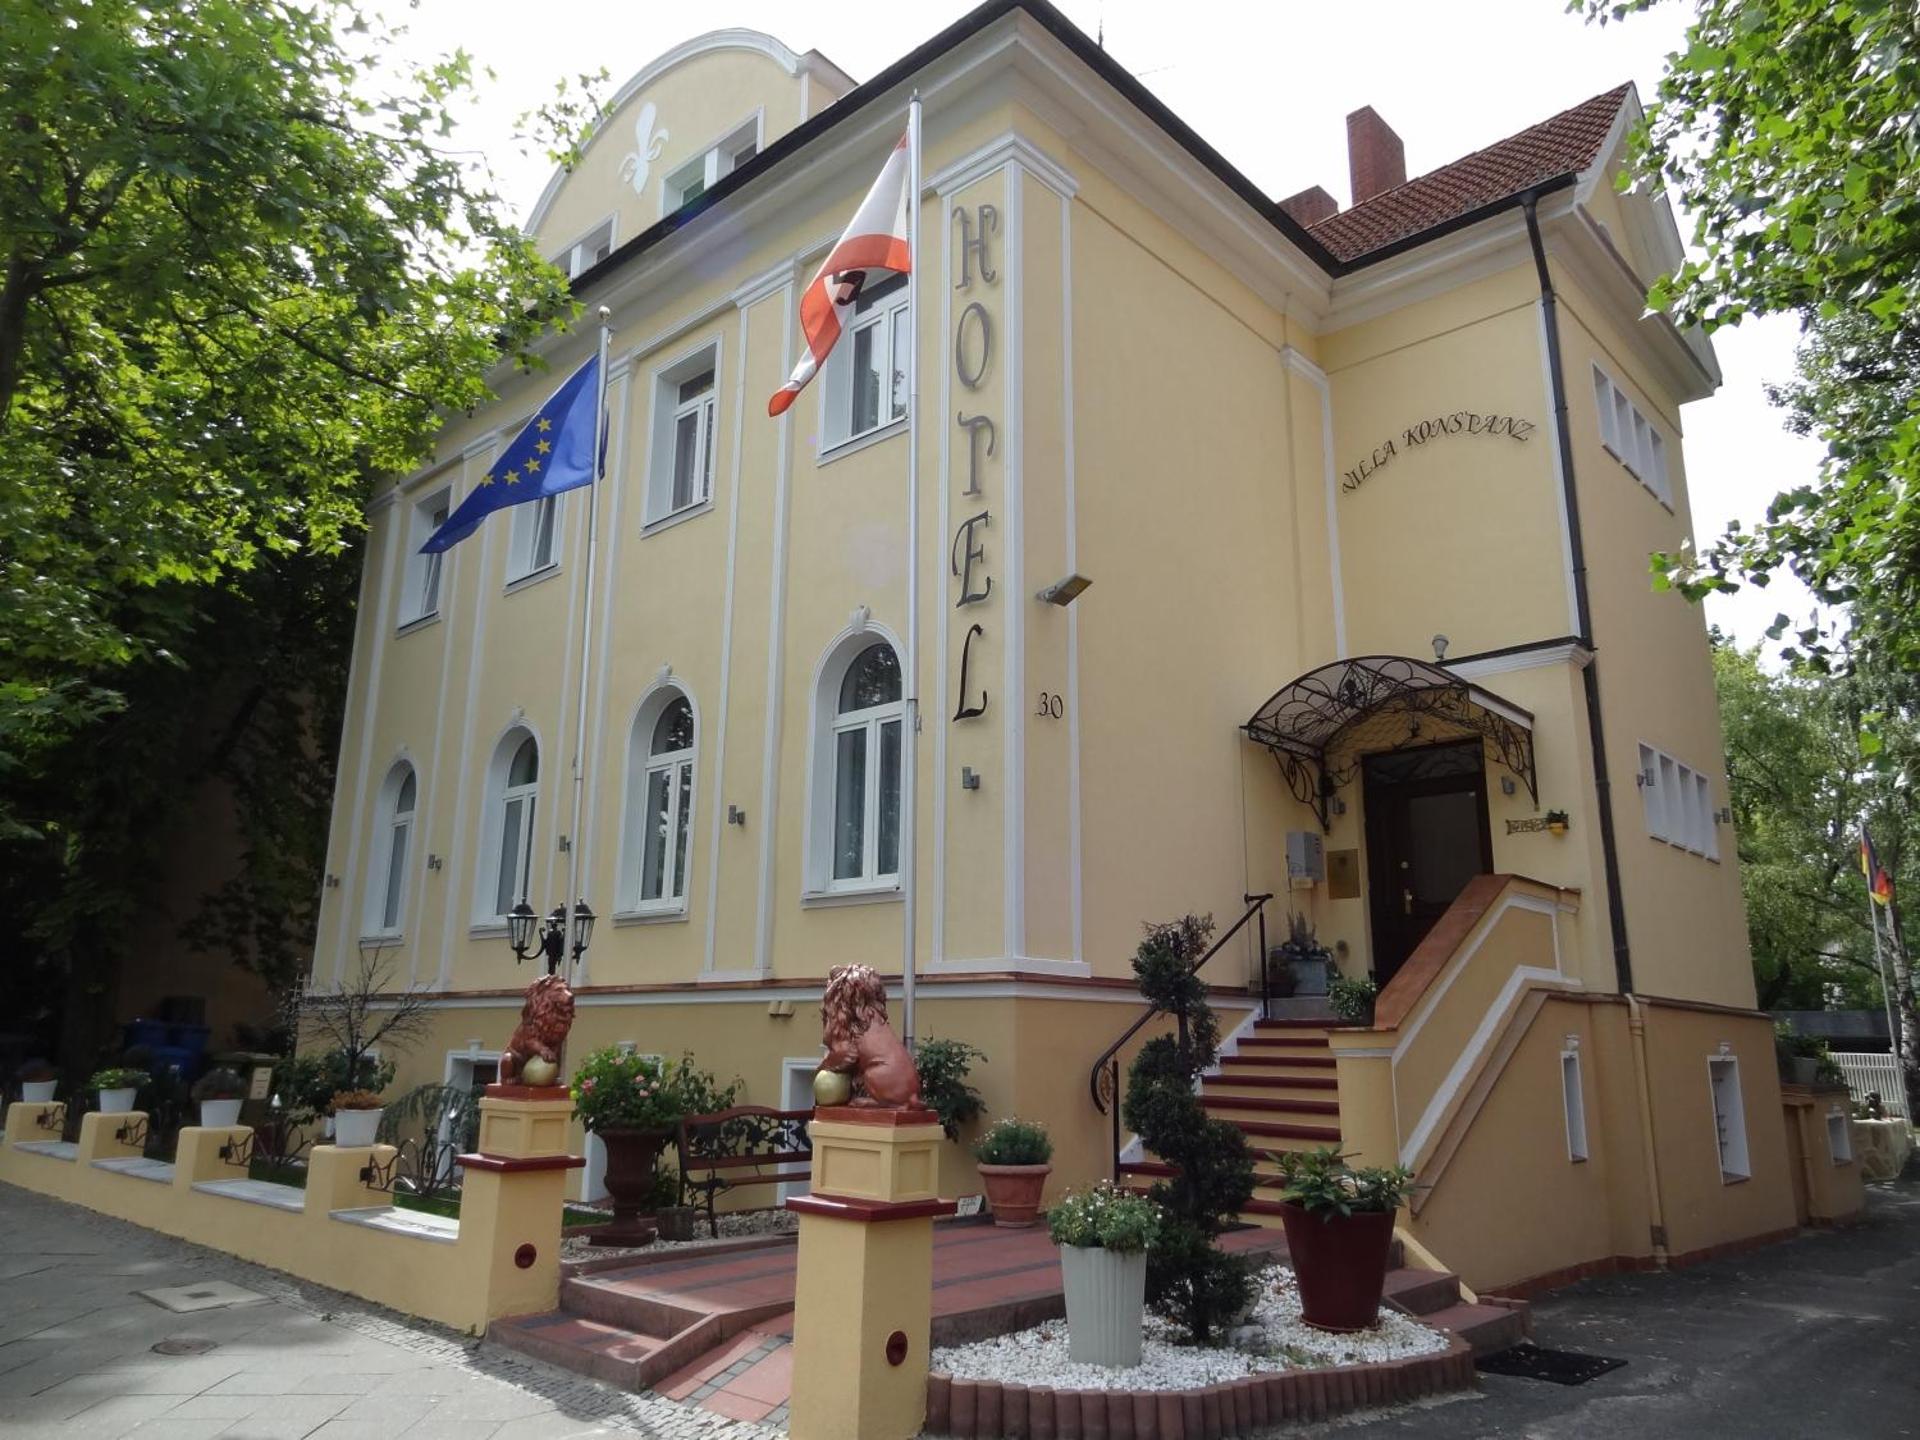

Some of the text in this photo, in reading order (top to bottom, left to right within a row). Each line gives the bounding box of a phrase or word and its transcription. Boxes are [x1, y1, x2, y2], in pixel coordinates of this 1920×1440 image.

[952, 204, 998, 722] HOTEL
[1342, 410, 1536, 494] VILLA KONSTANZ
[1034, 691, 1063, 719] 30
